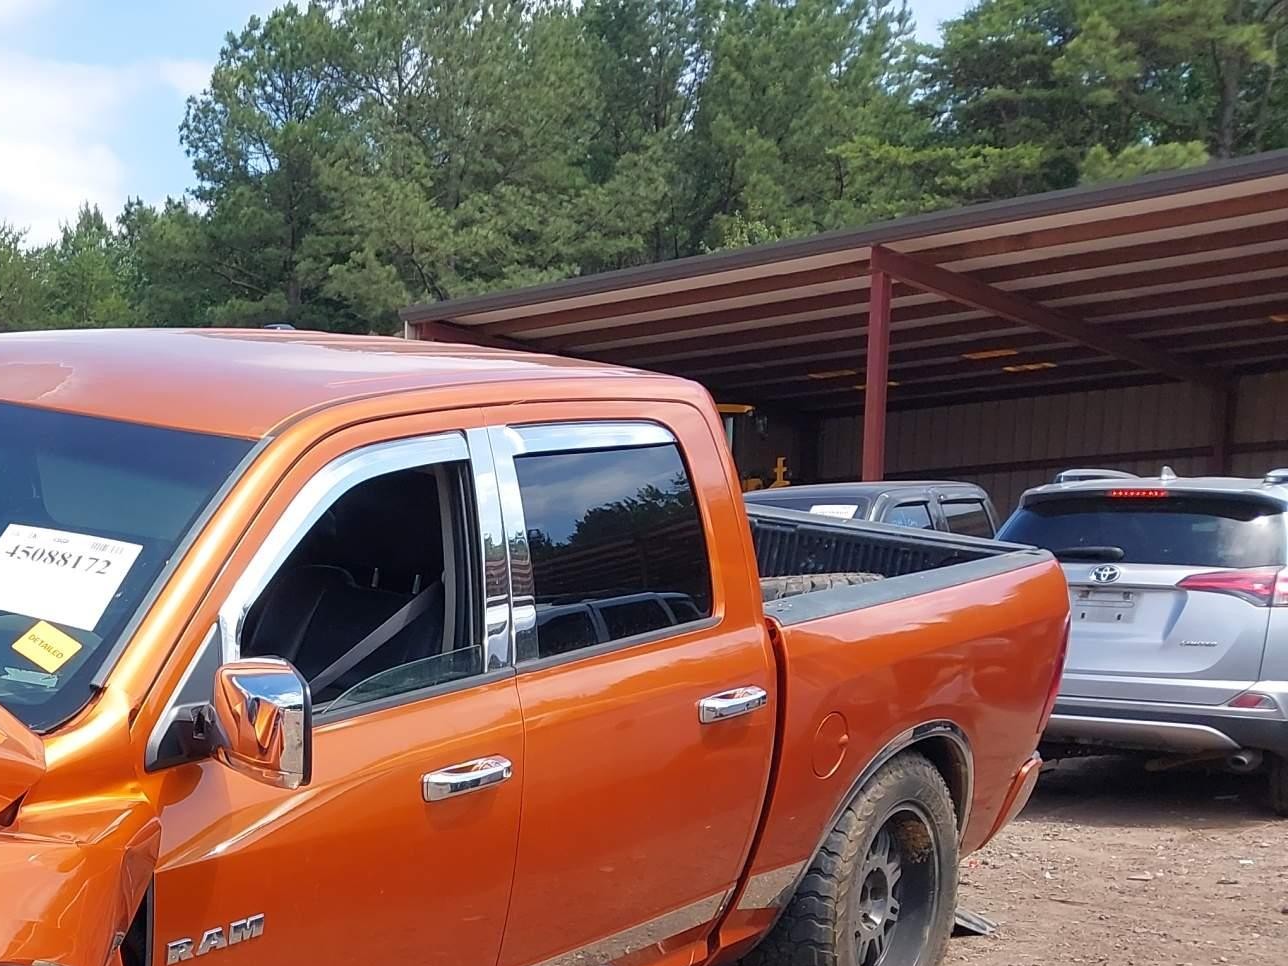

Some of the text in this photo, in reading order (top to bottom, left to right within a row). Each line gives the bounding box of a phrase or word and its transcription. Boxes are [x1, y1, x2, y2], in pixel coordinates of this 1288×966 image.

[4, 544, 112, 575] 45088172
[27, 633, 64, 659] DETAILED
[166, 913, 265, 966] RAM
